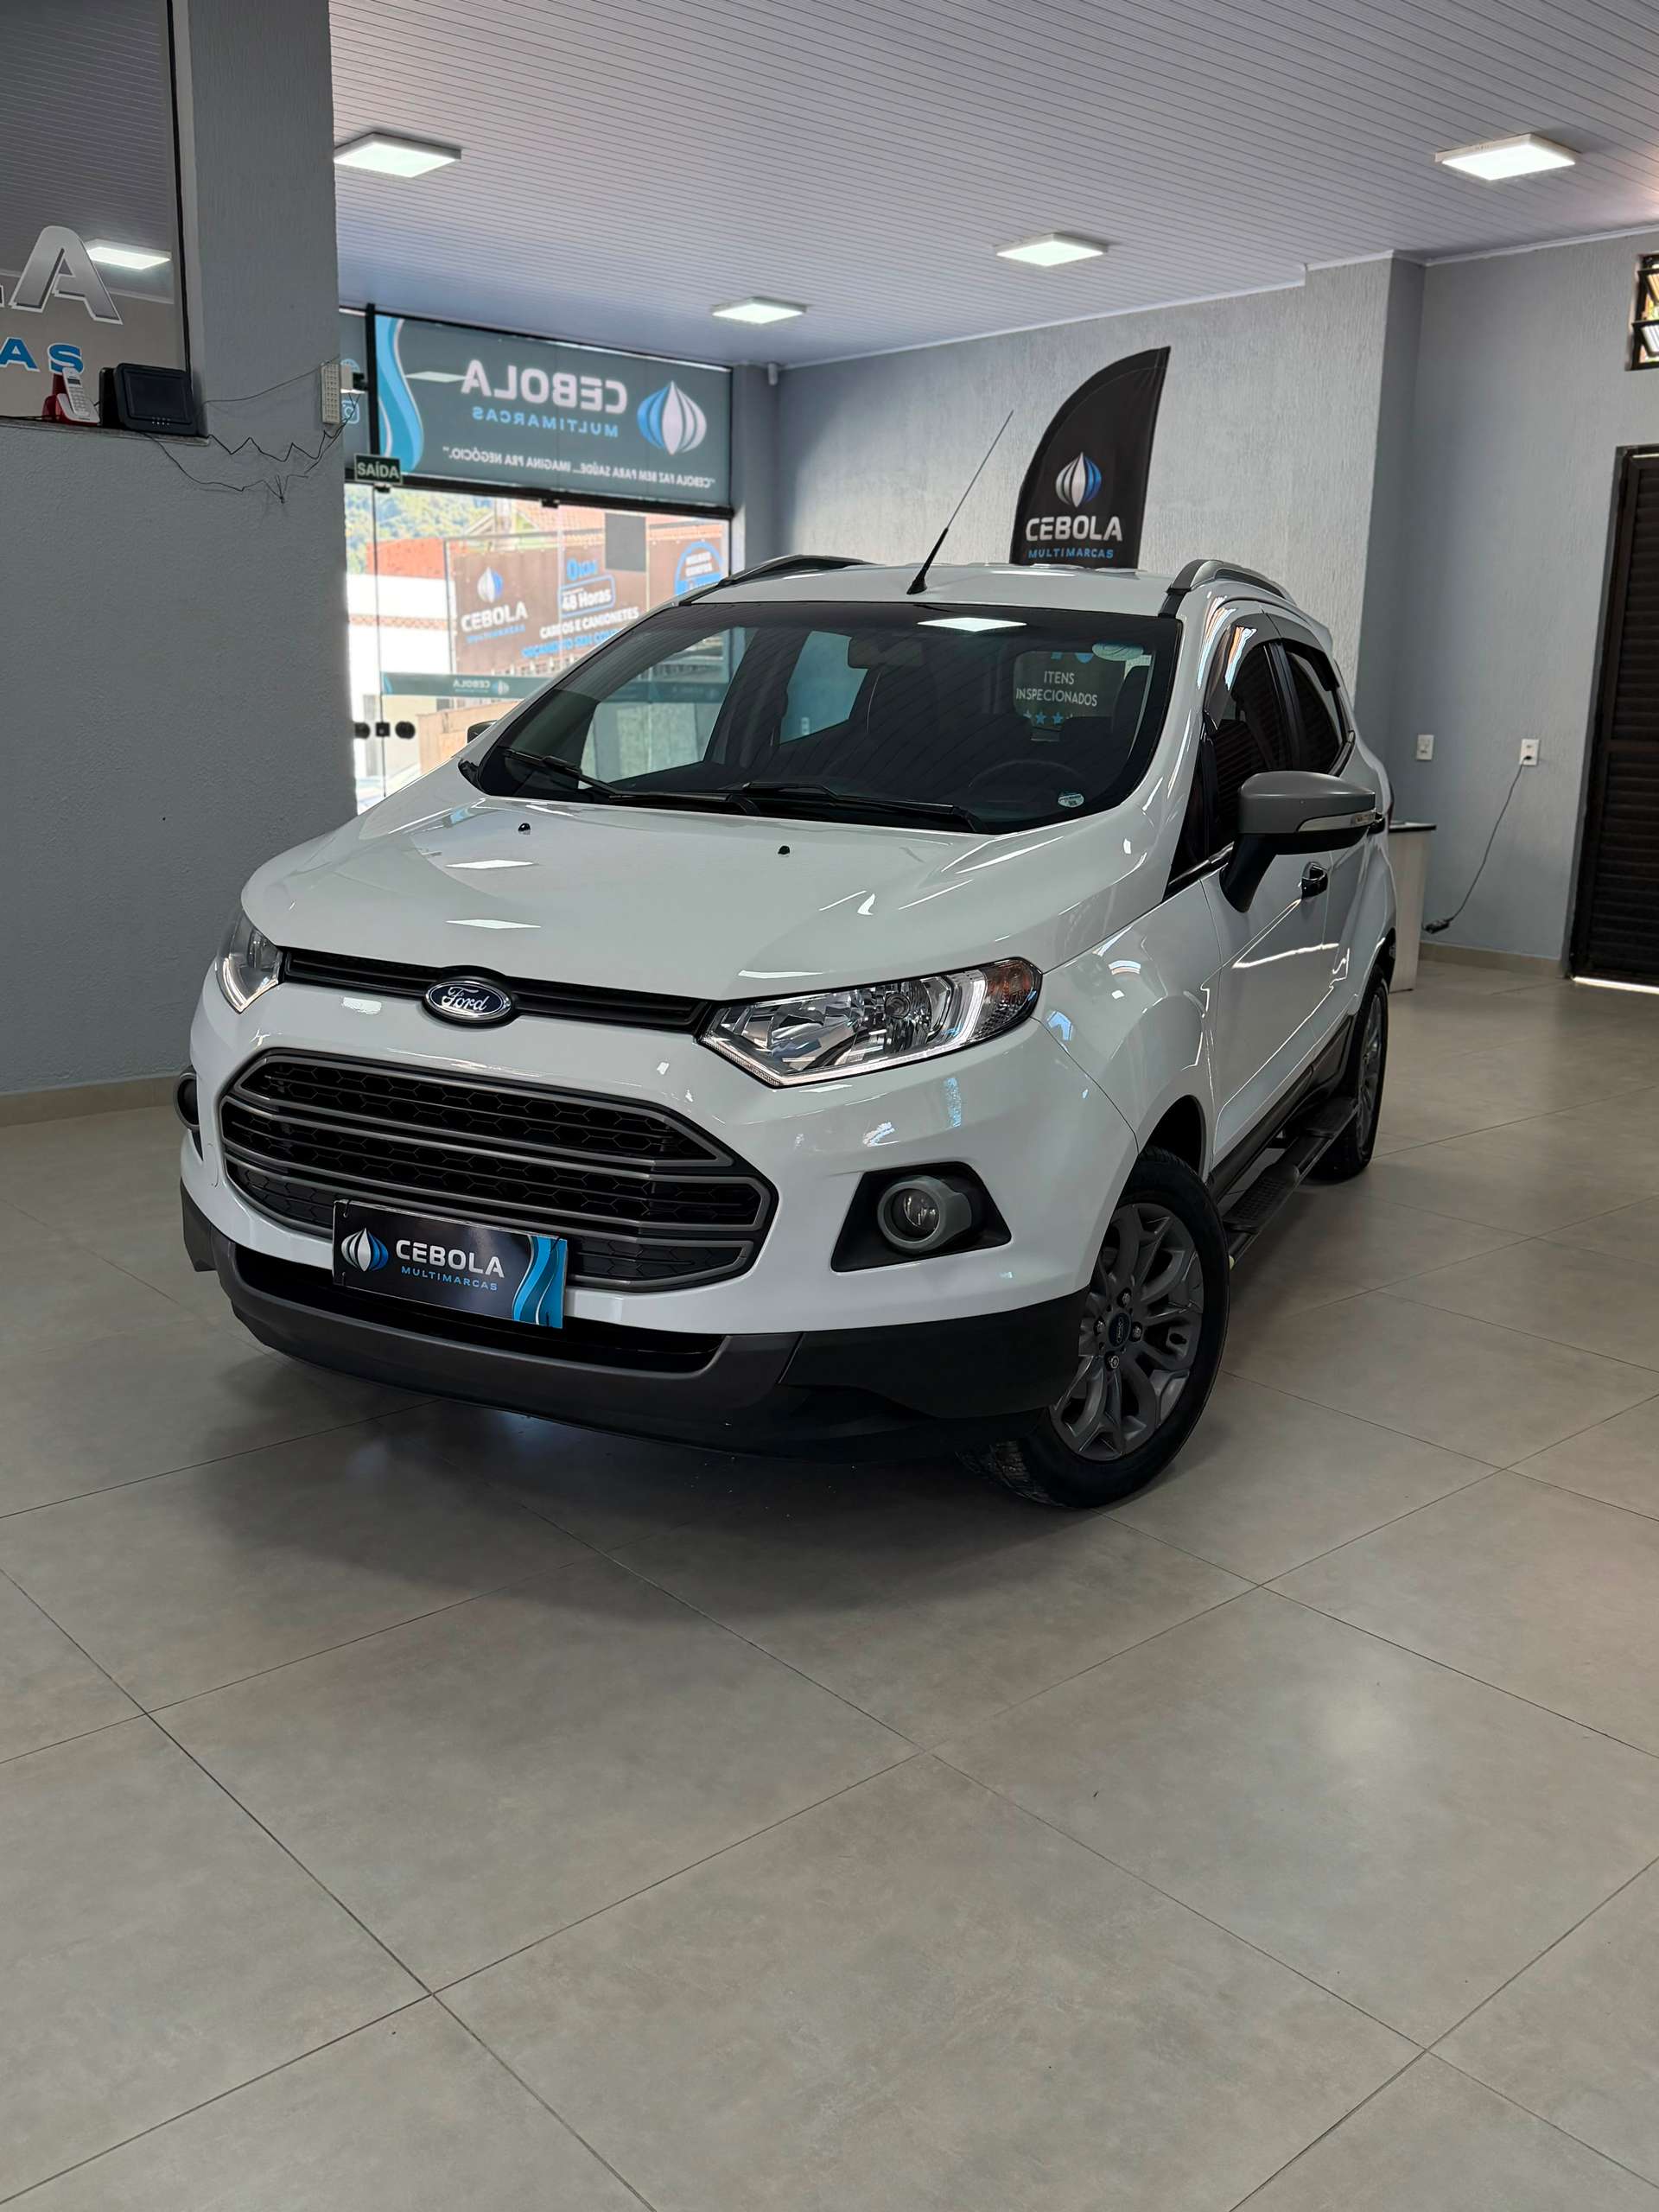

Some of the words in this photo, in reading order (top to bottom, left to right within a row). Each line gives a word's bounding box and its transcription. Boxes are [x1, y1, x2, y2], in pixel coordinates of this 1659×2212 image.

[0, 226, 123, 325] A
[357, 461, 399, 479] SAÍDA
[1025, 515, 1122, 542] CEBOLA
[1028, 547, 1114, 559] MULTIMARCAS
[578, 588, 613, 608] Horas
[461, 601, 528, 632] CEBOLA
[1044, 671, 1075, 685] ITENS
[1016, 687, 1097, 707] INSPECIONADOS
[442, 986, 490, 1011] Ford
[396, 1239, 505, 1279] CEBOLA
[401, 1265, 499, 1292] MULTIMARCAS
